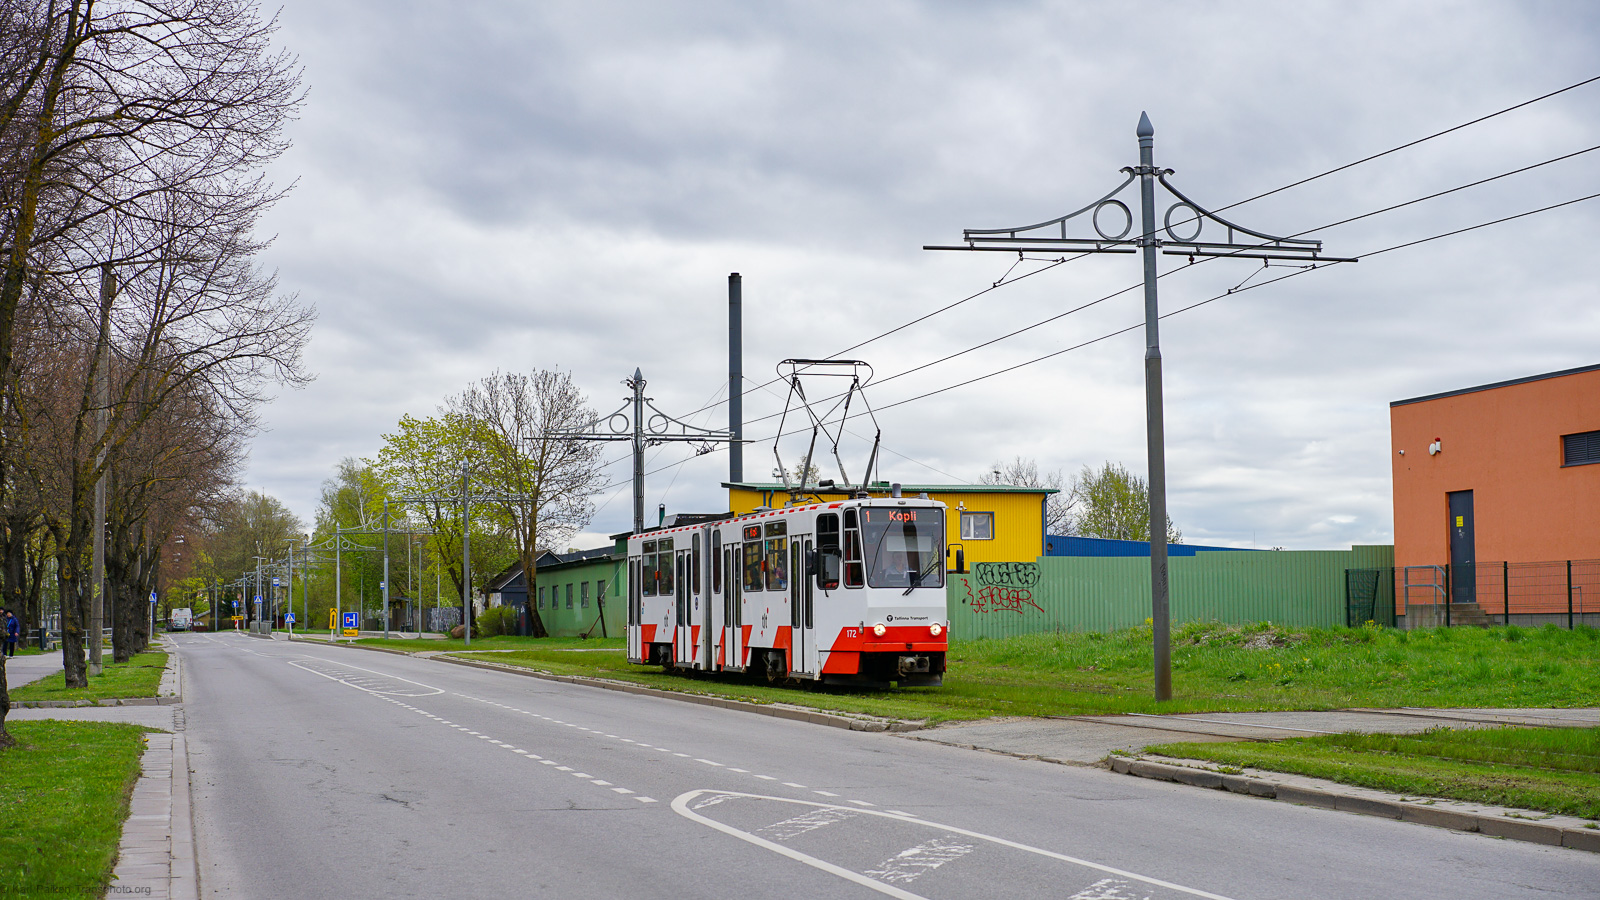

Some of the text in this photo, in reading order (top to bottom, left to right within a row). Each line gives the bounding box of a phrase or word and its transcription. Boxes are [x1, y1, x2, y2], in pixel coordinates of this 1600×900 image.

[865, 510, 917, 523] 1 Kopli
[846, 629, 857, 638] 172
